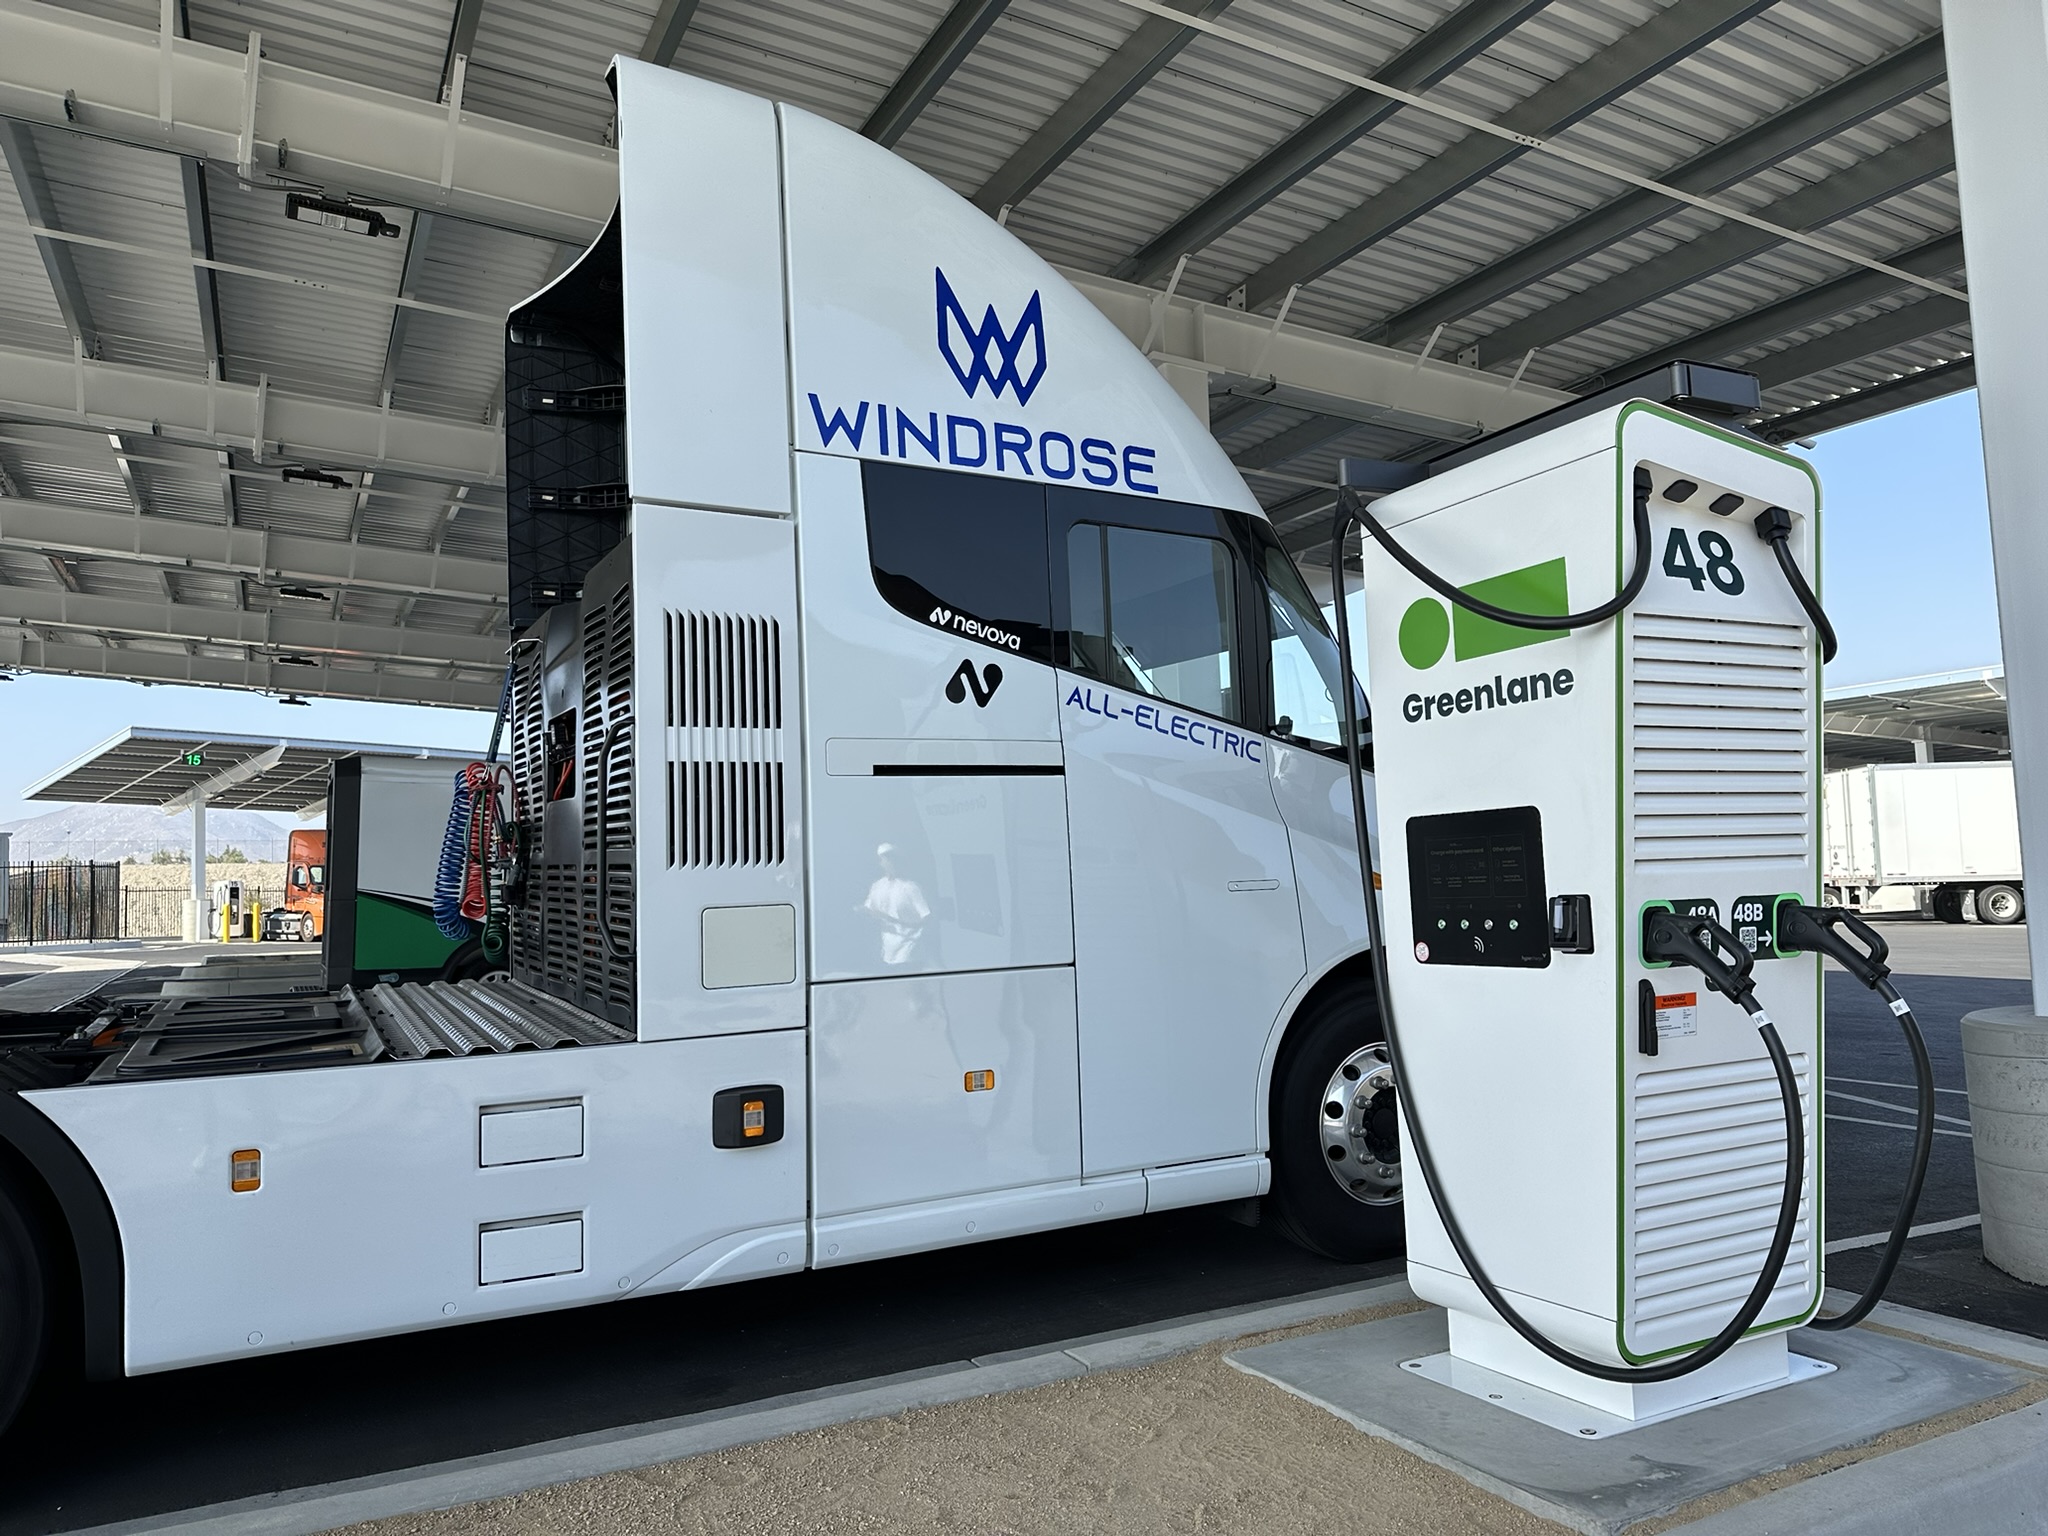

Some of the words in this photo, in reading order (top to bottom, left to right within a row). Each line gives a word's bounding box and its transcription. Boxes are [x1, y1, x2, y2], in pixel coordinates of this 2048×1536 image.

[807, 392, 1160, 495] WINDROSE
[1662, 527, 1745, 597] 48
[952, 614, 1022, 651] nevoya
[1401, 667, 1575, 724] Greenlane
[1065, 685, 1262, 764] ALL-ELECTRIC
[186, 754, 201, 766] 15
[1734, 903, 1764, 923] 48B
